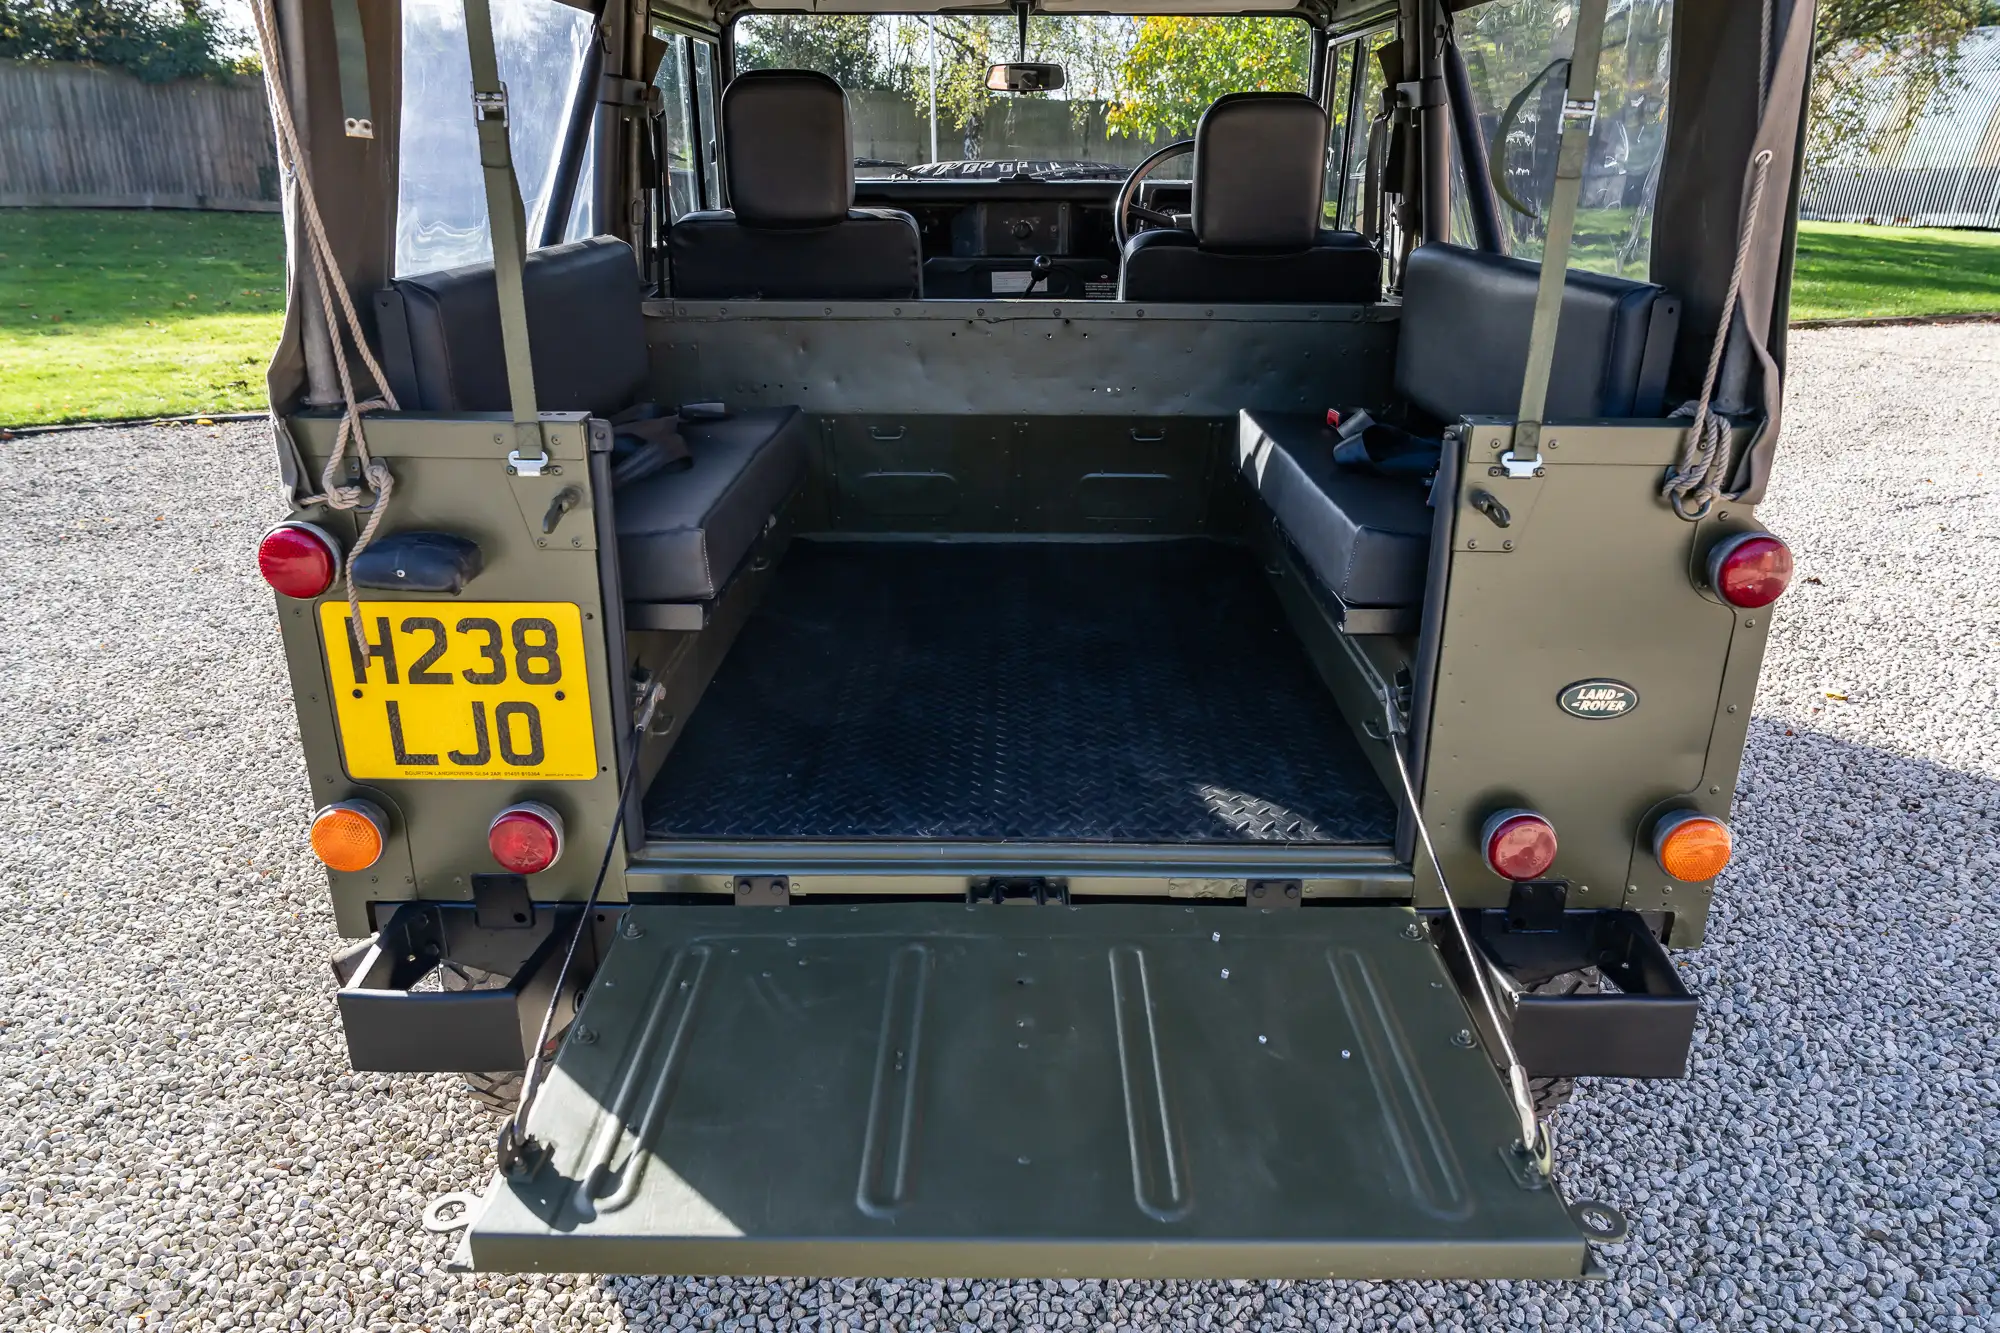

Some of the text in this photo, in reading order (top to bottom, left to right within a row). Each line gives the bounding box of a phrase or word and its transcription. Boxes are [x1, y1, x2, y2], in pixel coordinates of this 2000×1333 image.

[344, 616, 563, 685] H238
[1577, 688, 1616, 700] LAND
[1578, 700, 1627, 711] ROVER
[385, 700, 545, 766] LJO
